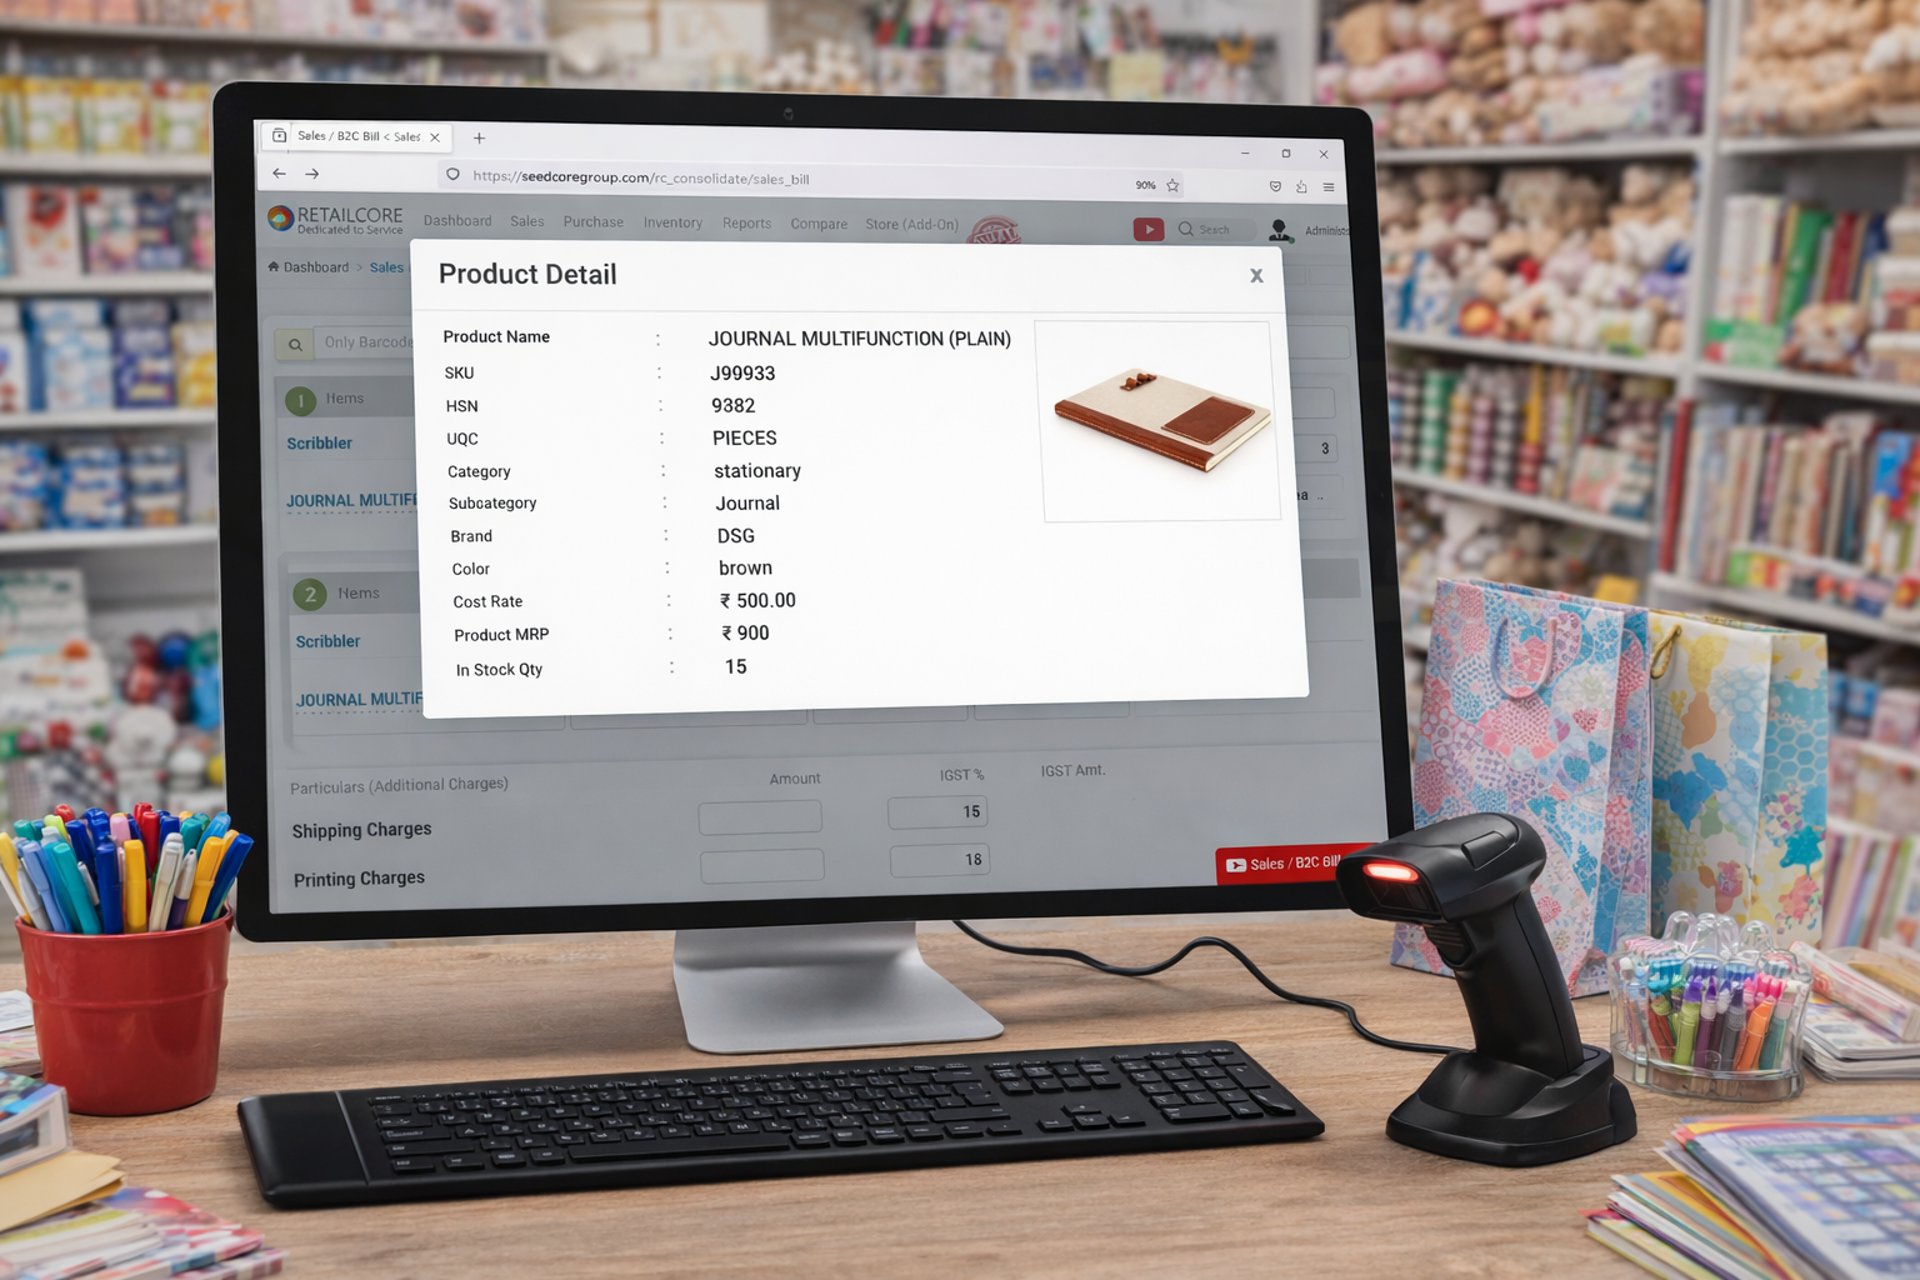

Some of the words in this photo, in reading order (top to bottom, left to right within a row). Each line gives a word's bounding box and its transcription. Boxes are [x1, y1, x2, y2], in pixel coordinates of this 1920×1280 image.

[298, 130, 326, 141] Sales
[337, 131, 360, 141] B2C
[363, 130, 380, 142] Bill
[394, 131, 421, 142] Sales
[472, 169, 810, 187] https://seedcoregroup.com/rc_consolidate/sales_bill
[1135, 180, 1157, 190] 90%
[297, 207, 404, 224] RETAILCORE
[423, 212, 493, 229] Dashboard
[510, 214, 545, 229] Sales
[563, 214, 624, 230] Purchase
[643, 215, 703, 233] Inventory
[722, 215, 772, 232] Reports
[297, 224, 350, 235] Dedicated
[353, 225, 364, 235] to
[366, 224, 404, 235] Service
[790, 217, 848, 234] Compare
[865, 216, 898, 232] Store
[901, 215, 960, 234] (Add-On)
[284, 261, 350, 273] Dashboard
[369, 262, 404, 274] Sales
[439, 261, 539, 287] Product
[545, 261, 618, 286] Detail
[325, 335, 356, 349] Only
[442, 329, 502, 345] Product
[506, 329, 551, 344] Name
[708, 329, 797, 348] JOURNAL
[801, 329, 945, 348] MULTIFUNCTION
[948, 329, 1013, 350] (PLAIN)
[444, 365, 475, 381] SKU
[710, 365, 776, 382] J99933
[446, 399, 479, 413] HSN
[711, 397, 757, 414] 9382
[287, 436, 353, 450] Scribbler
[446, 431, 479, 447] UQC
[712, 429, 778, 447] PIECES
[1321, 442, 1330, 455] 3
[447, 464, 511, 481] Category
[714, 462, 802, 482] stationary
[286, 493, 355, 508] JOURNAL
[448, 495, 537, 513] Subcategory
[715, 494, 781, 512] Journal
[450, 529, 493, 543] Brand
[717, 527, 756, 545] DSG
[452, 561, 491, 576] Color
[718, 559, 773, 576] brown
[304, 587, 317, 603] 2
[453, 594, 487, 609] Cost
[490, 594, 524, 609] Rate
[720, 592, 732, 609] ₹
[736, 592, 797, 609] 500.00
[295, 634, 361, 648] Scribbler
[453, 627, 512, 643] Product
[515, 627, 550, 642] MRP
[722, 625, 733, 642] ₹
[737, 625, 770, 642] 900
[456, 663, 470, 677] In
[473, 662, 516, 677] Stock
[519, 662, 544, 680] Qty
[725, 658, 748, 675] 15
[295, 693, 367, 707] JOURNAL
[769, 771, 822, 786] Amount
[940, 769, 971, 782] IGST
[973, 768, 985, 781] %
[1041, 764, 1073, 778] IGST
[1075, 764, 1107, 777] Amt.
[290, 779, 365, 796] Particulars
[368, 777, 445, 796] (Additional
[448, 775, 509, 794] Charges)
[963, 805, 981, 819] 15
[292, 823, 363, 843] Shipping
[366, 821, 432, 841] Charges
[965, 852, 983, 866] 18
[1250, 857, 1285, 871] Sales
[1295, 856, 1320, 869] B2C
[293, 872, 356, 891] Printing
[360, 870, 426, 889] Charges
